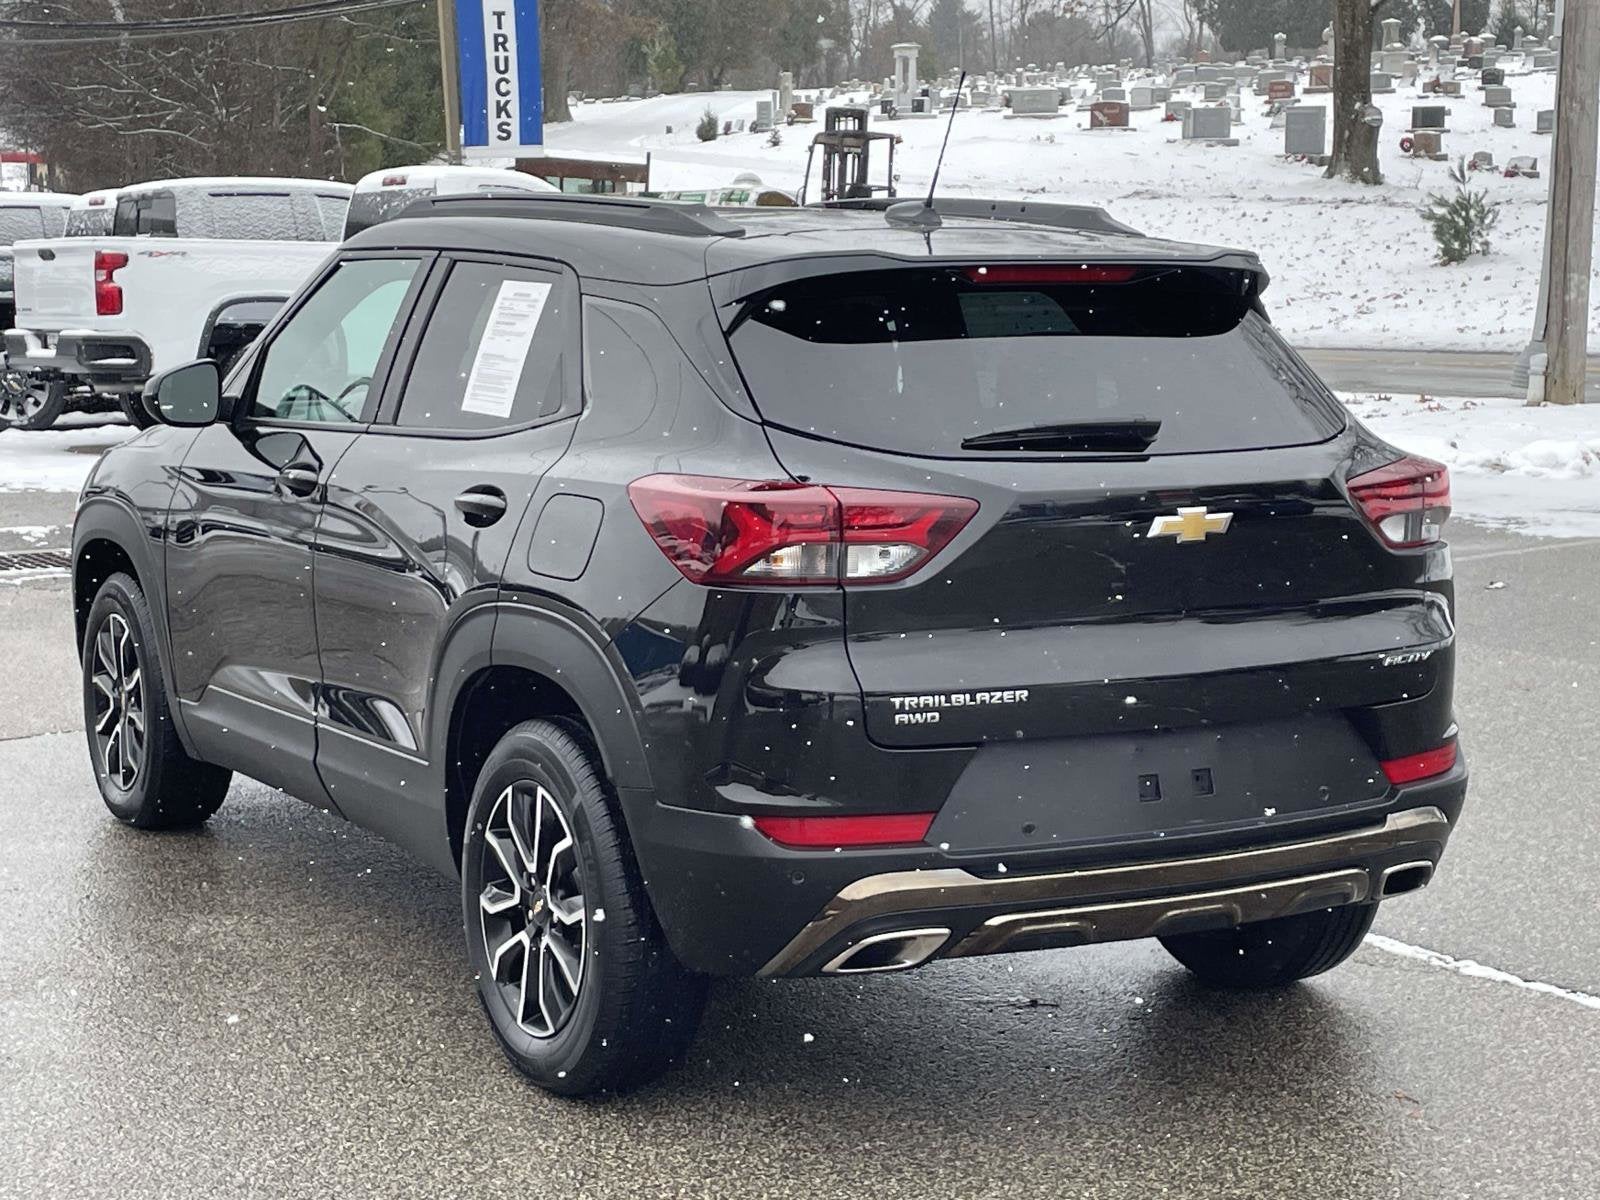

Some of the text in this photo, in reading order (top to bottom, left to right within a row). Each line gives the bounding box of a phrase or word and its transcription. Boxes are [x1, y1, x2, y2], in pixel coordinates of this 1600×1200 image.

[492, 10, 512, 141] TRUCKS
[890, 690, 1029, 710] TRAILBLAZER
[894, 711, 940, 725] AWD
